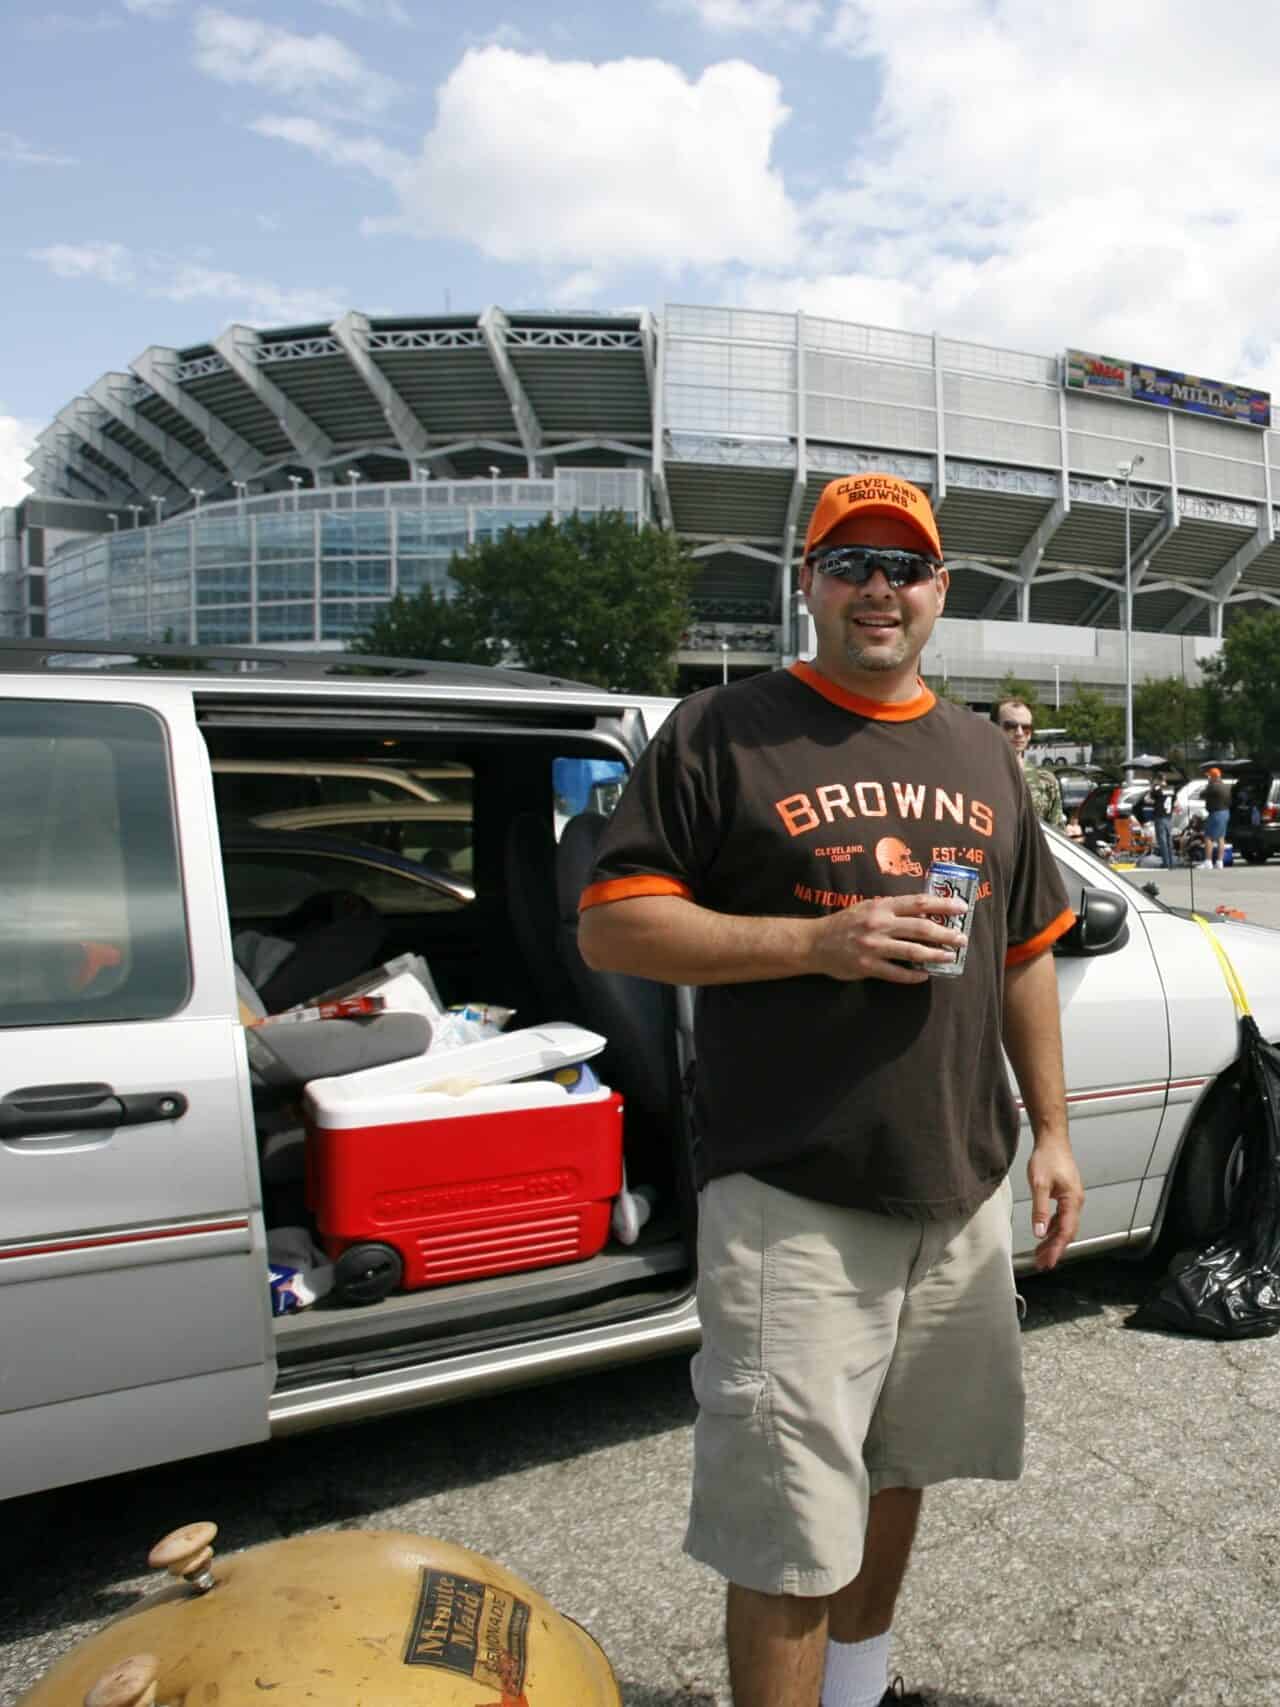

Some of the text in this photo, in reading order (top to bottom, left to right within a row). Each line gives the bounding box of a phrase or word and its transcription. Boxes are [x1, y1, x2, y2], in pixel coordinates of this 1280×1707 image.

[837, 478, 918, 503] CLEVELAND
[848, 489, 909, 508] BROWNS
[775, 782, 994, 837] BROWNS
[415, 1576, 456, 1657] Minute
[449, 1591, 481, 1650] Maid
[485, 1598, 507, 1673] LEMONADE
